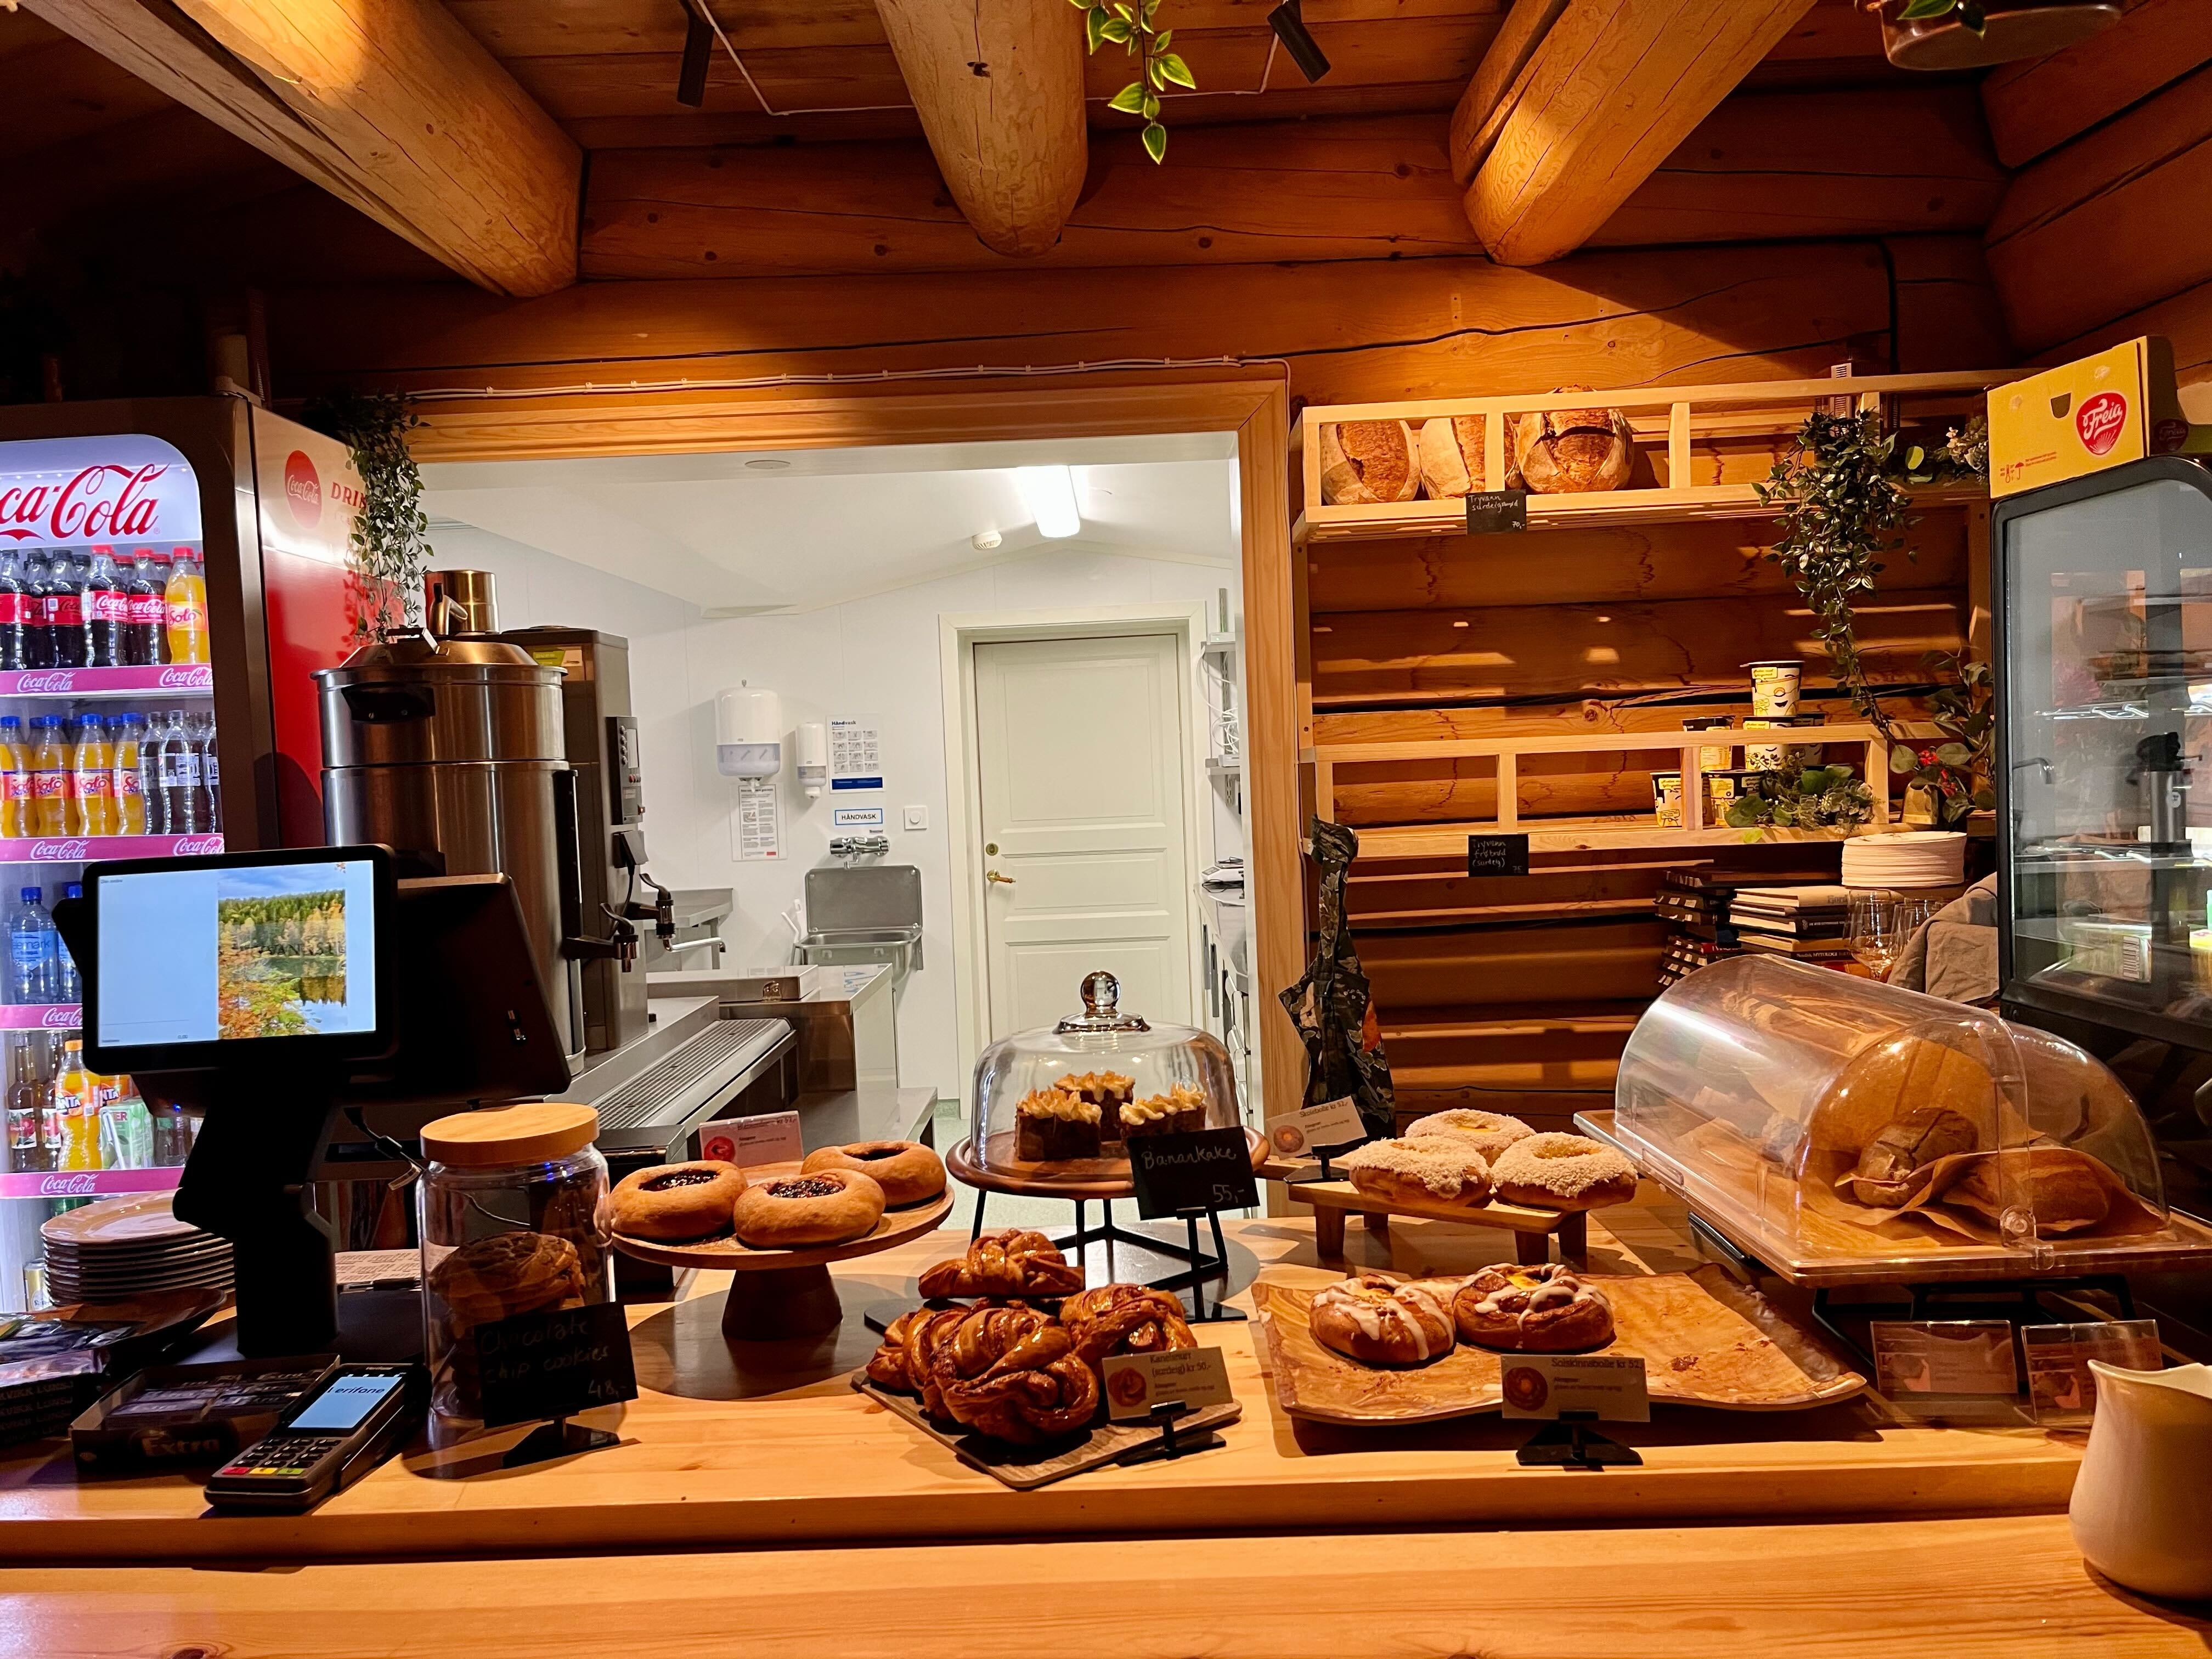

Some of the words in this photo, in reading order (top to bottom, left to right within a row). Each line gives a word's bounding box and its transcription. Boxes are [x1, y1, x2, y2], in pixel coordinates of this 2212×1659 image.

[2083, 398, 2124, 441] Freia
[287, 475, 319, 505] Coca-Cola
[330, 481, 366, 509] DRIN
[1468, 494, 1501, 506] Tryvann
[0, 462, 171, 541] ca-Cola
[168, 609, 196, 626] Solo
[17, 672, 76, 692] Coca-Cola
[30, 840, 90, 860] Coca-Cola
[173, 837, 224, 856] Coca-Col
[41, 1174, 99, 1194] Coca-Cola
[1213, 1184, 1245, 1203] 55,-
